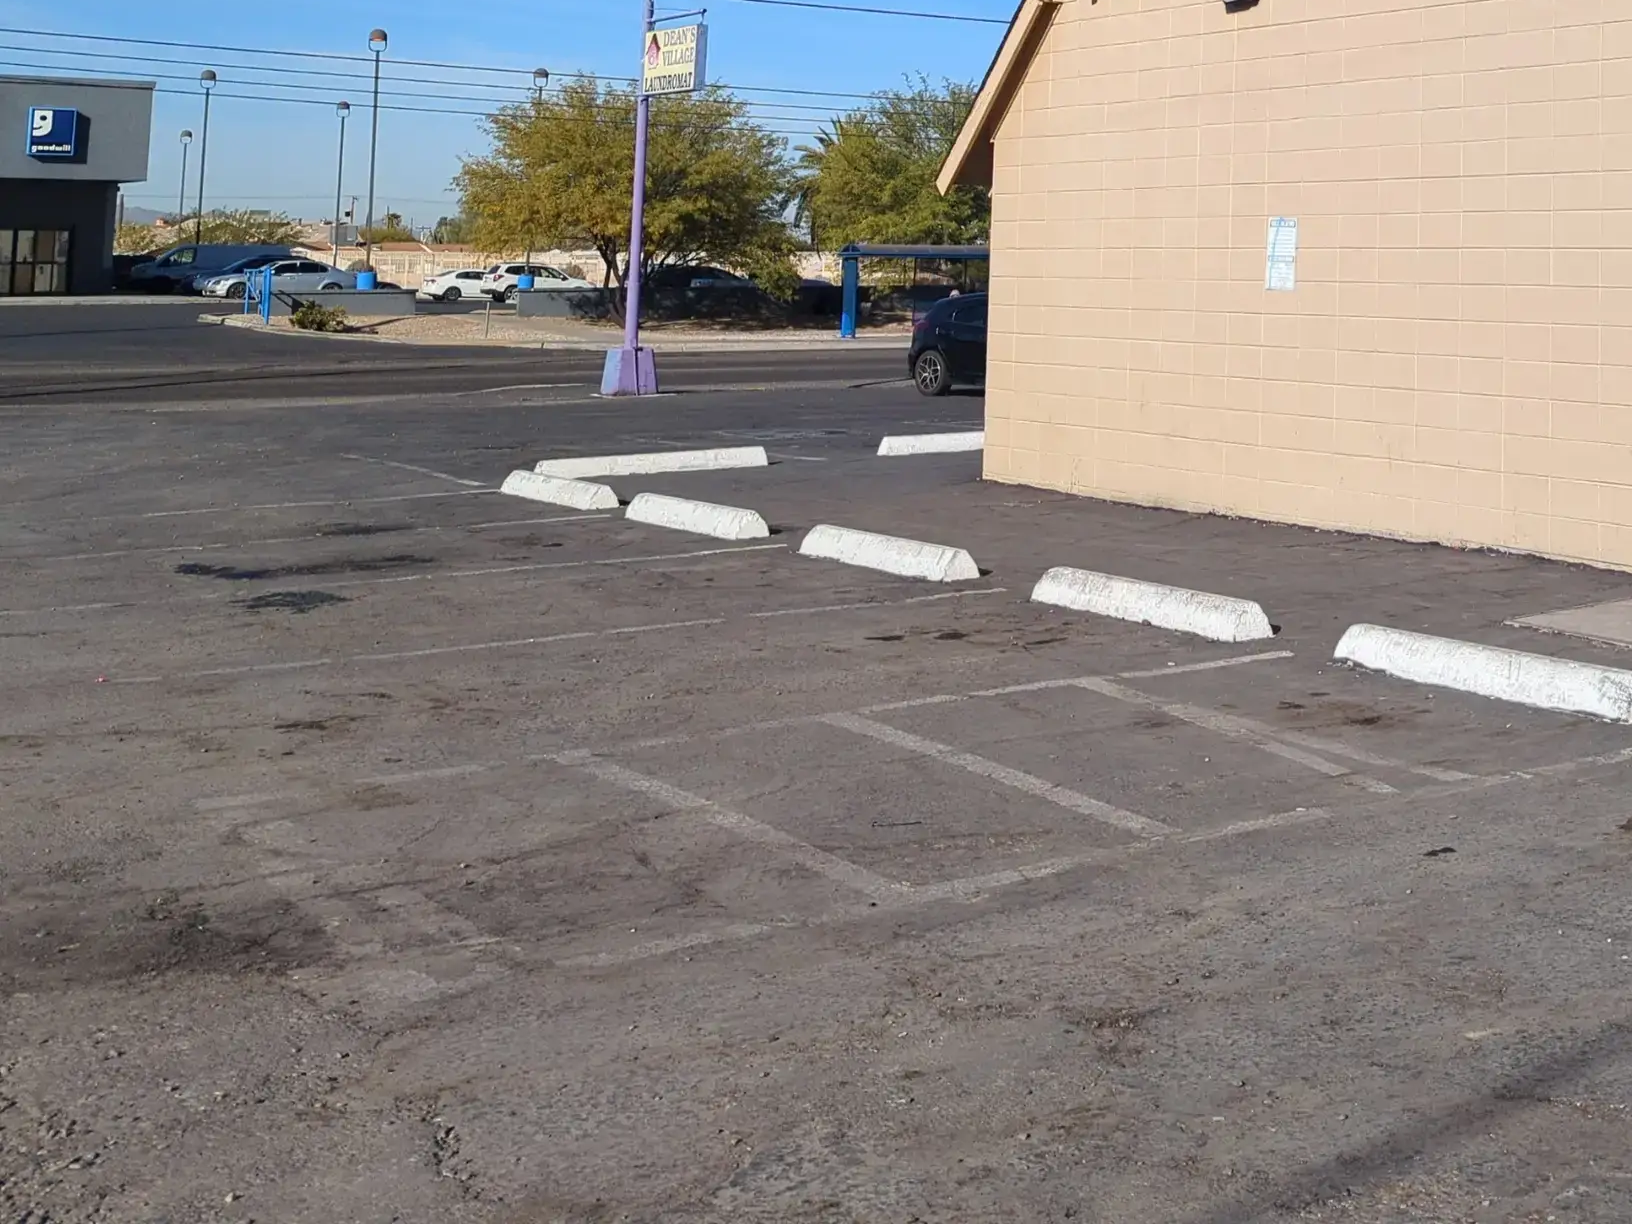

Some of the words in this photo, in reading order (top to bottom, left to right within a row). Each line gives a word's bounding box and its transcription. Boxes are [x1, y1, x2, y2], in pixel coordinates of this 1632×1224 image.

[663, 26, 696, 47] DEAN'S
[662, 46, 695, 67] VILLAGE
[644, 71, 693, 93] LAUNDROMAT
[31, 144, 70, 153] goodwill
